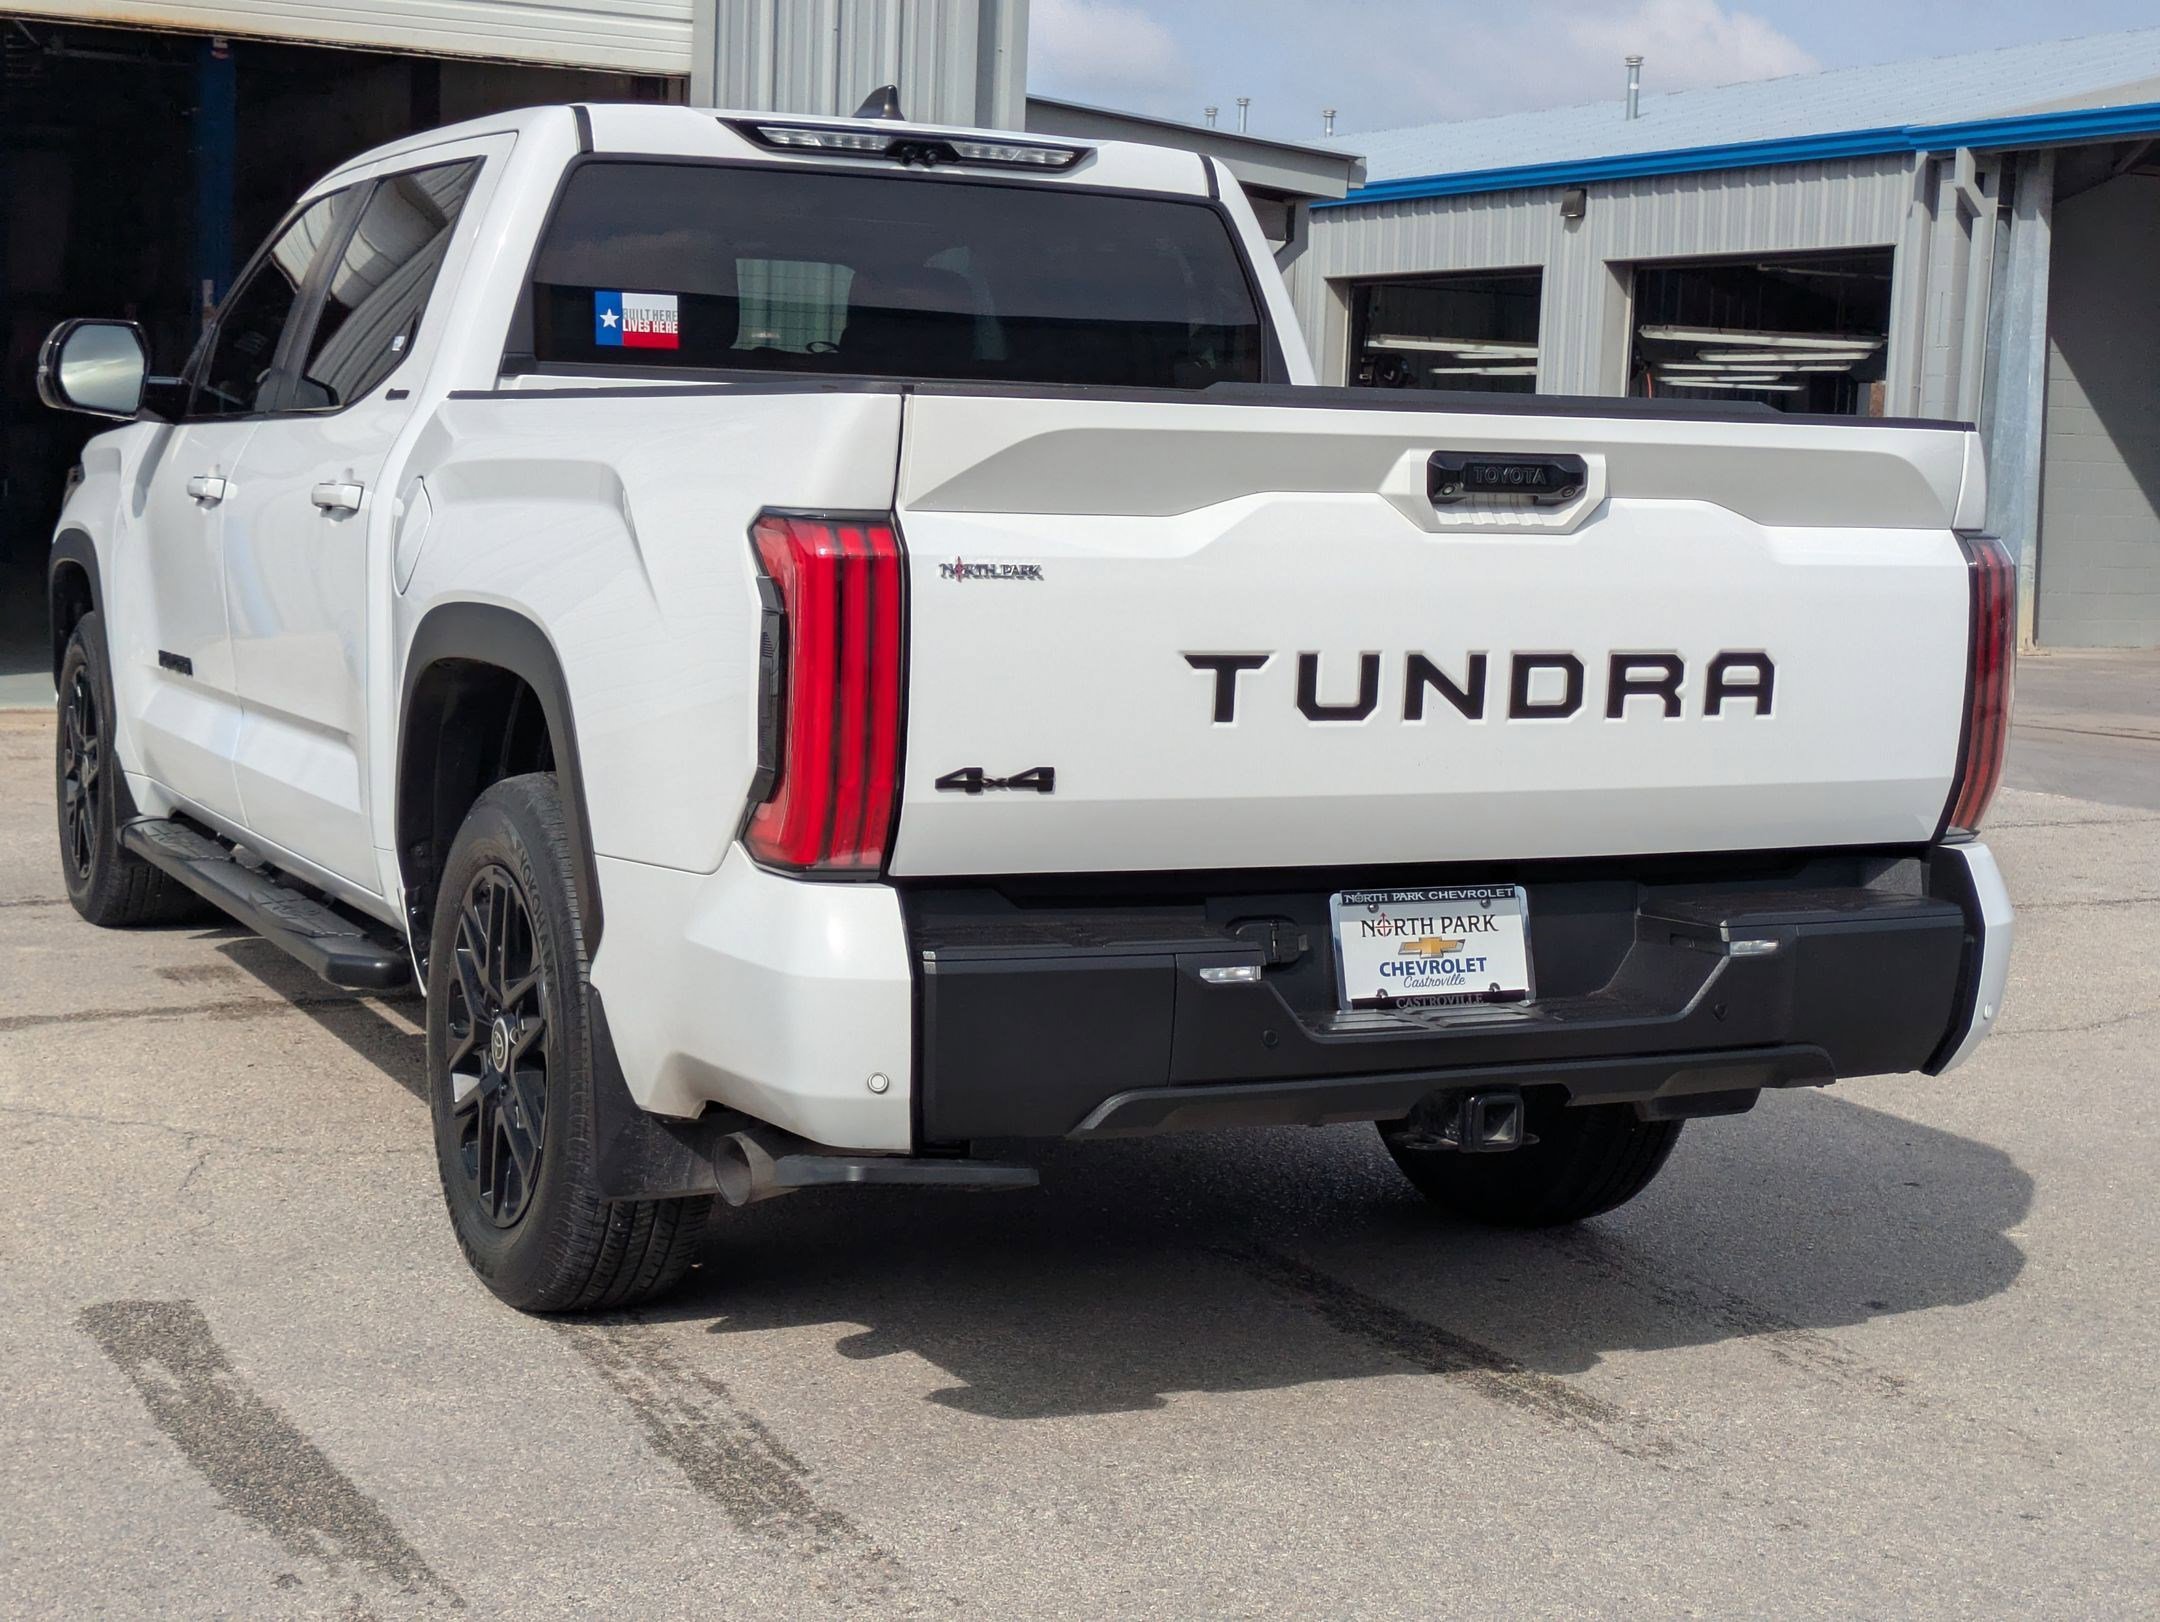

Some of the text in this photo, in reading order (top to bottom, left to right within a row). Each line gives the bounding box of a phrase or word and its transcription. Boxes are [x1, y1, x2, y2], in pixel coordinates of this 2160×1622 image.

[623, 308, 678, 322] BUILT HERE
[623, 319, 678, 334] LIVES HERE
[1473, 466, 1547, 485] TOYOTA
[1000, 563, 1043, 579] PARK
[1183, 651, 1776, 723] TUNDRA
[1344, 888, 1514, 904] NORTH PARK CHEVROLET
[1361, 914, 1499, 937] NORTH PARK
[1379, 957, 1487, 977] CHEVROLET
[1403, 973, 1466, 989] Castroville
[1395, 993, 1483, 1009] CASTROVILLE
